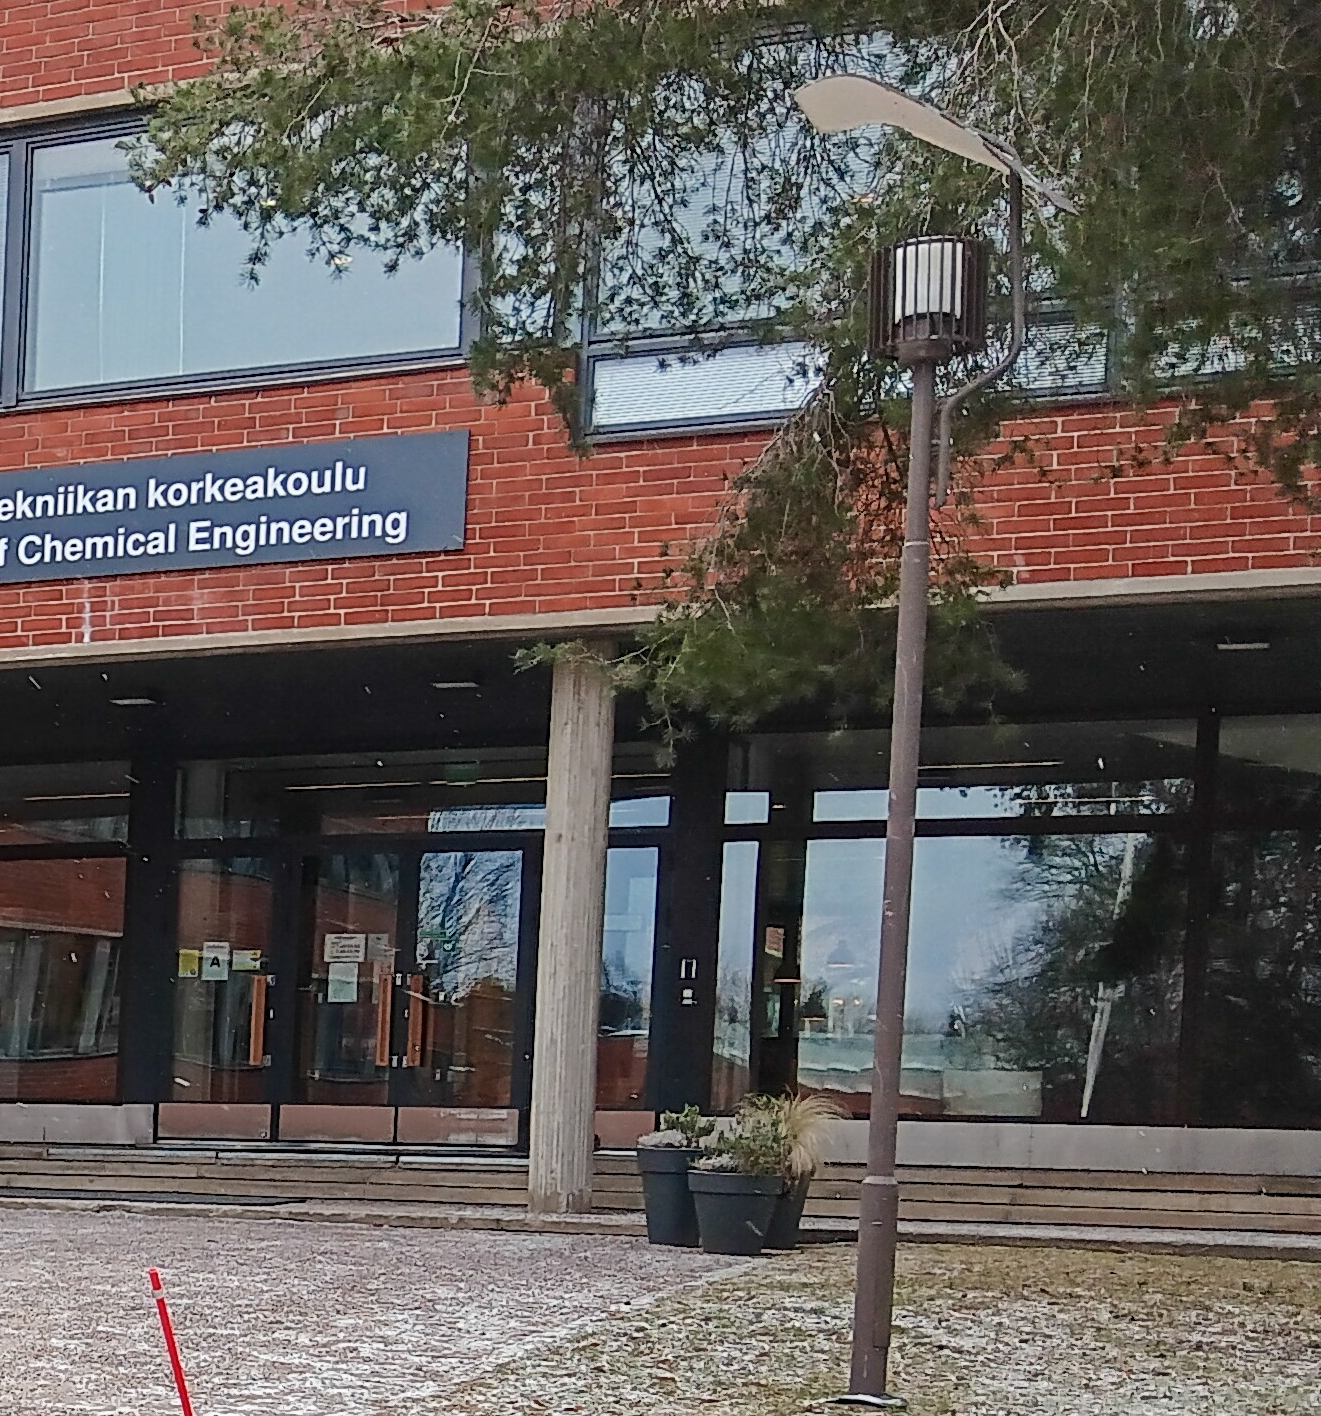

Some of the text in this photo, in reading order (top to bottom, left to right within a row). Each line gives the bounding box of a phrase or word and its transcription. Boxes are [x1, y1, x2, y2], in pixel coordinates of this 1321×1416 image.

[147, 461, 367, 508] korkeakoulu
[17, 523, 176, 566] Chemical
[187, 508, 408, 556] Engineering
[210, 956, 220, 968] A
